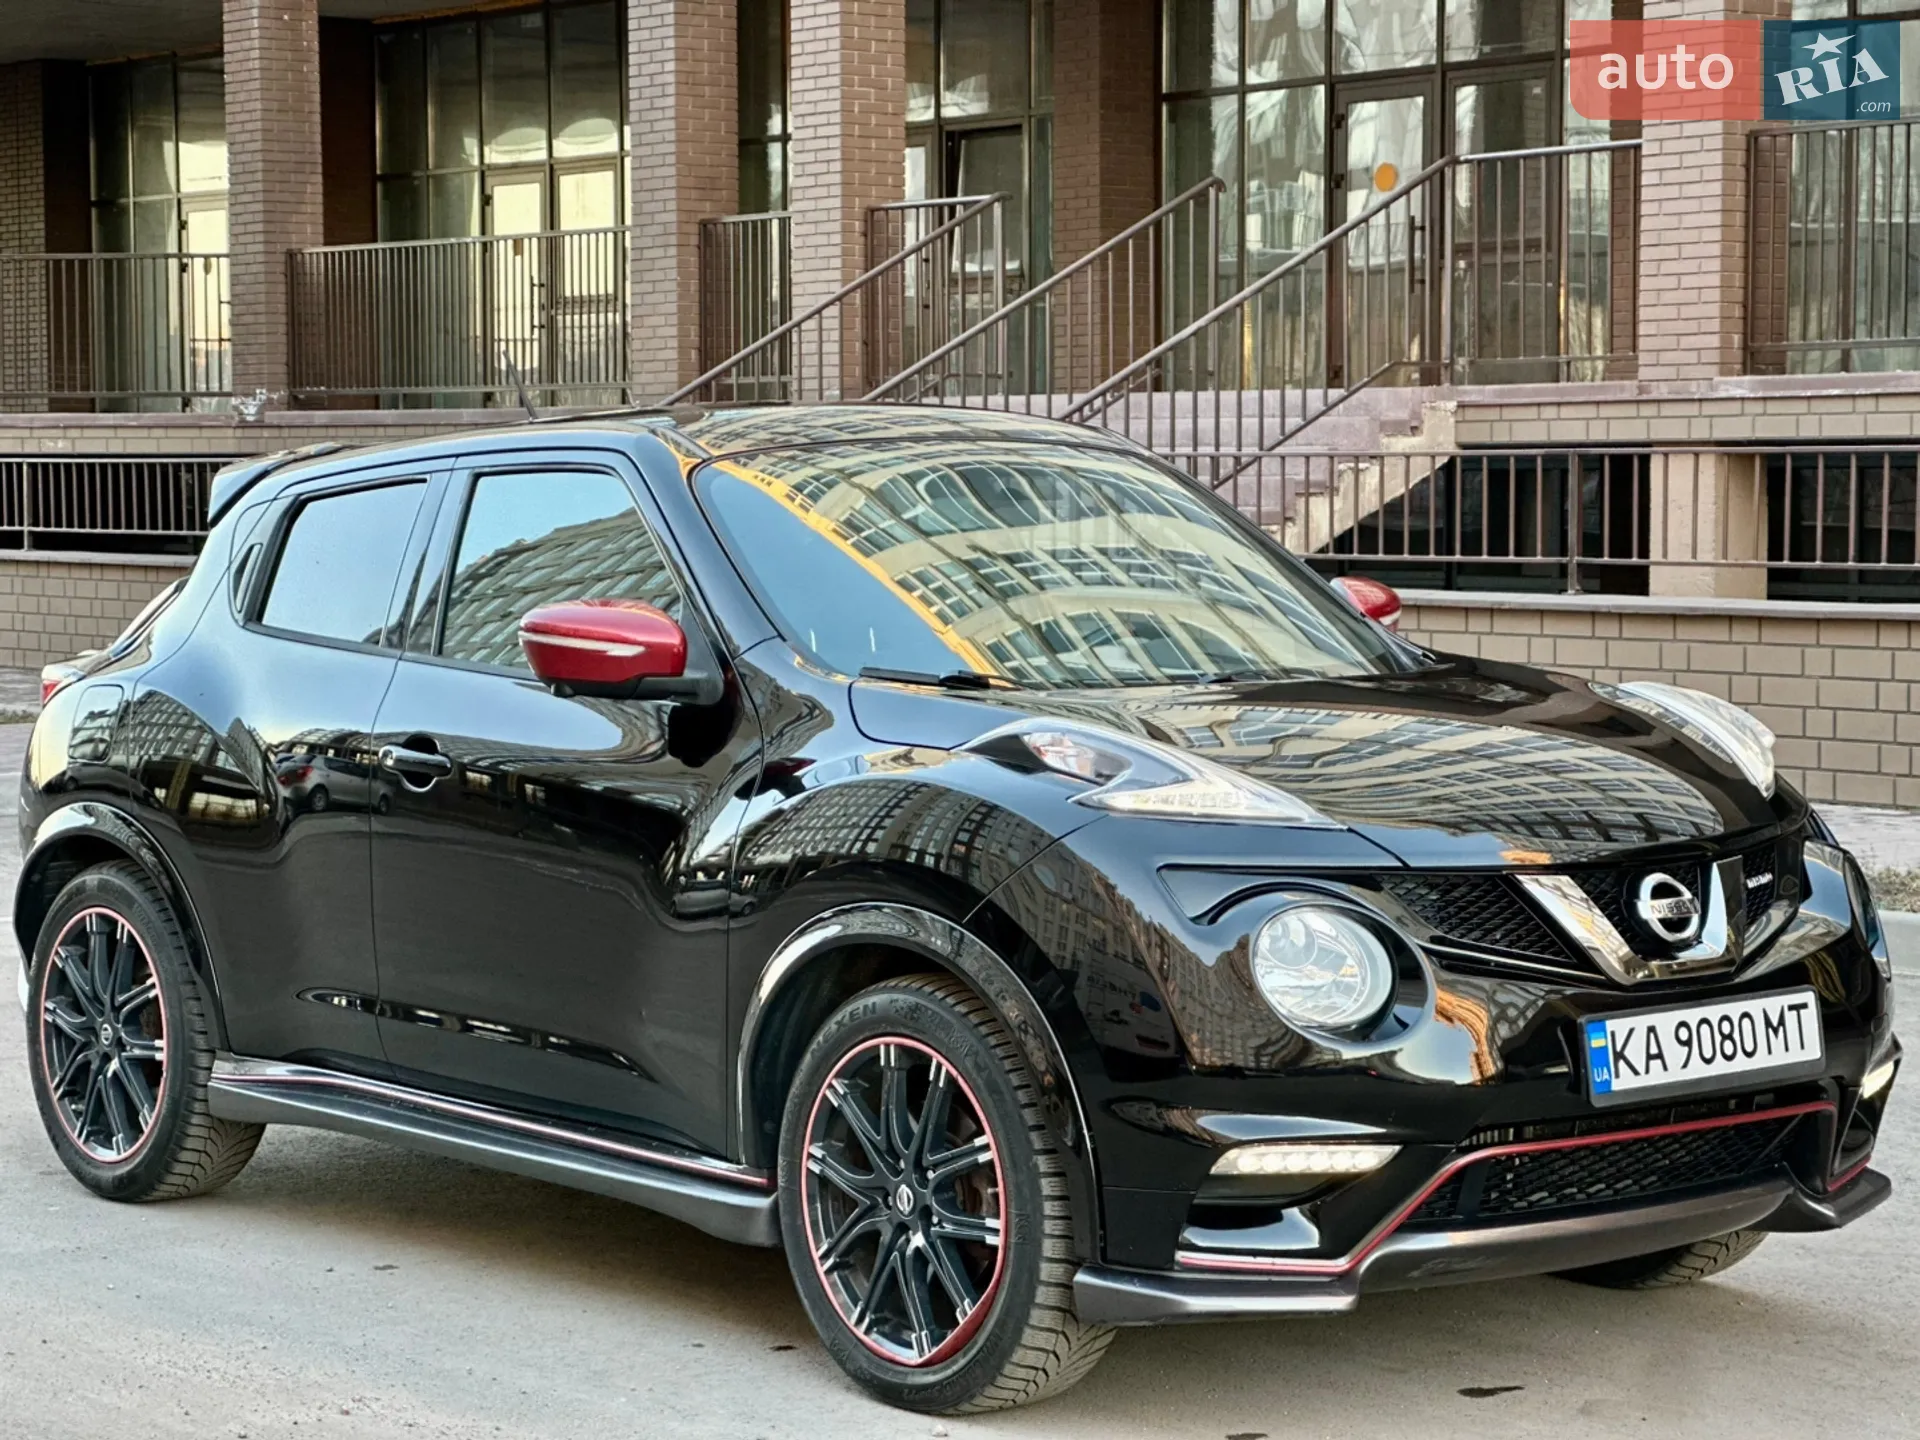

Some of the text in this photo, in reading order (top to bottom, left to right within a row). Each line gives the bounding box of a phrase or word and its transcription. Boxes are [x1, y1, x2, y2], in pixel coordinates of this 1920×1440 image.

[1610, 1002, 1809, 1080] KA 9080 MT
[1593, 1066, 1611, 1083] UA
